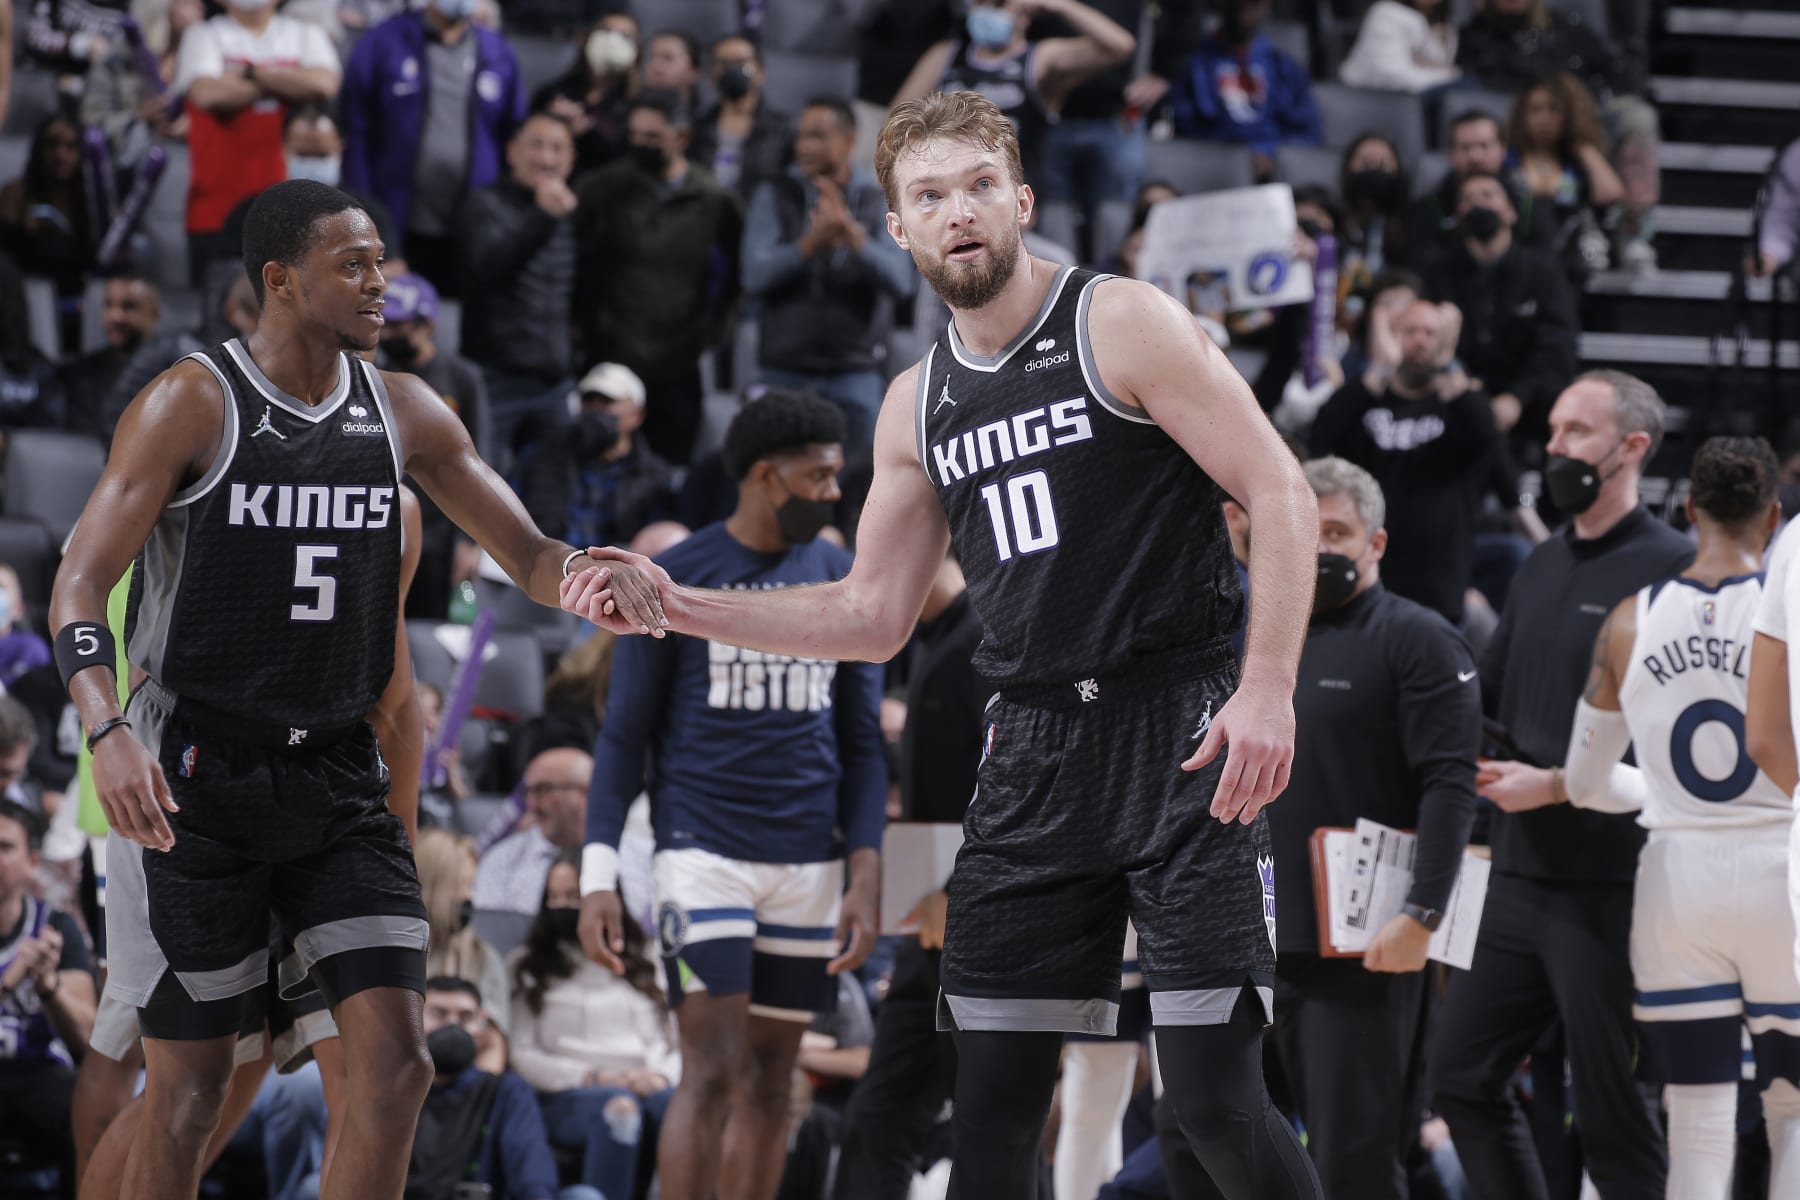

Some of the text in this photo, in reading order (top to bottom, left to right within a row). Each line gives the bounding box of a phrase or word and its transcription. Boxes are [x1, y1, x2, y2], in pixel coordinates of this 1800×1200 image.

[1024, 351, 1070, 373] dialpad
[342, 421, 385, 434] dialpad
[931, 395, 1094, 487] KINGS
[228, 482, 395, 530] KINGS
[981, 468, 1060, 563] 10
[290, 544, 338, 621] 5
[73, 626, 100, 656] 5
